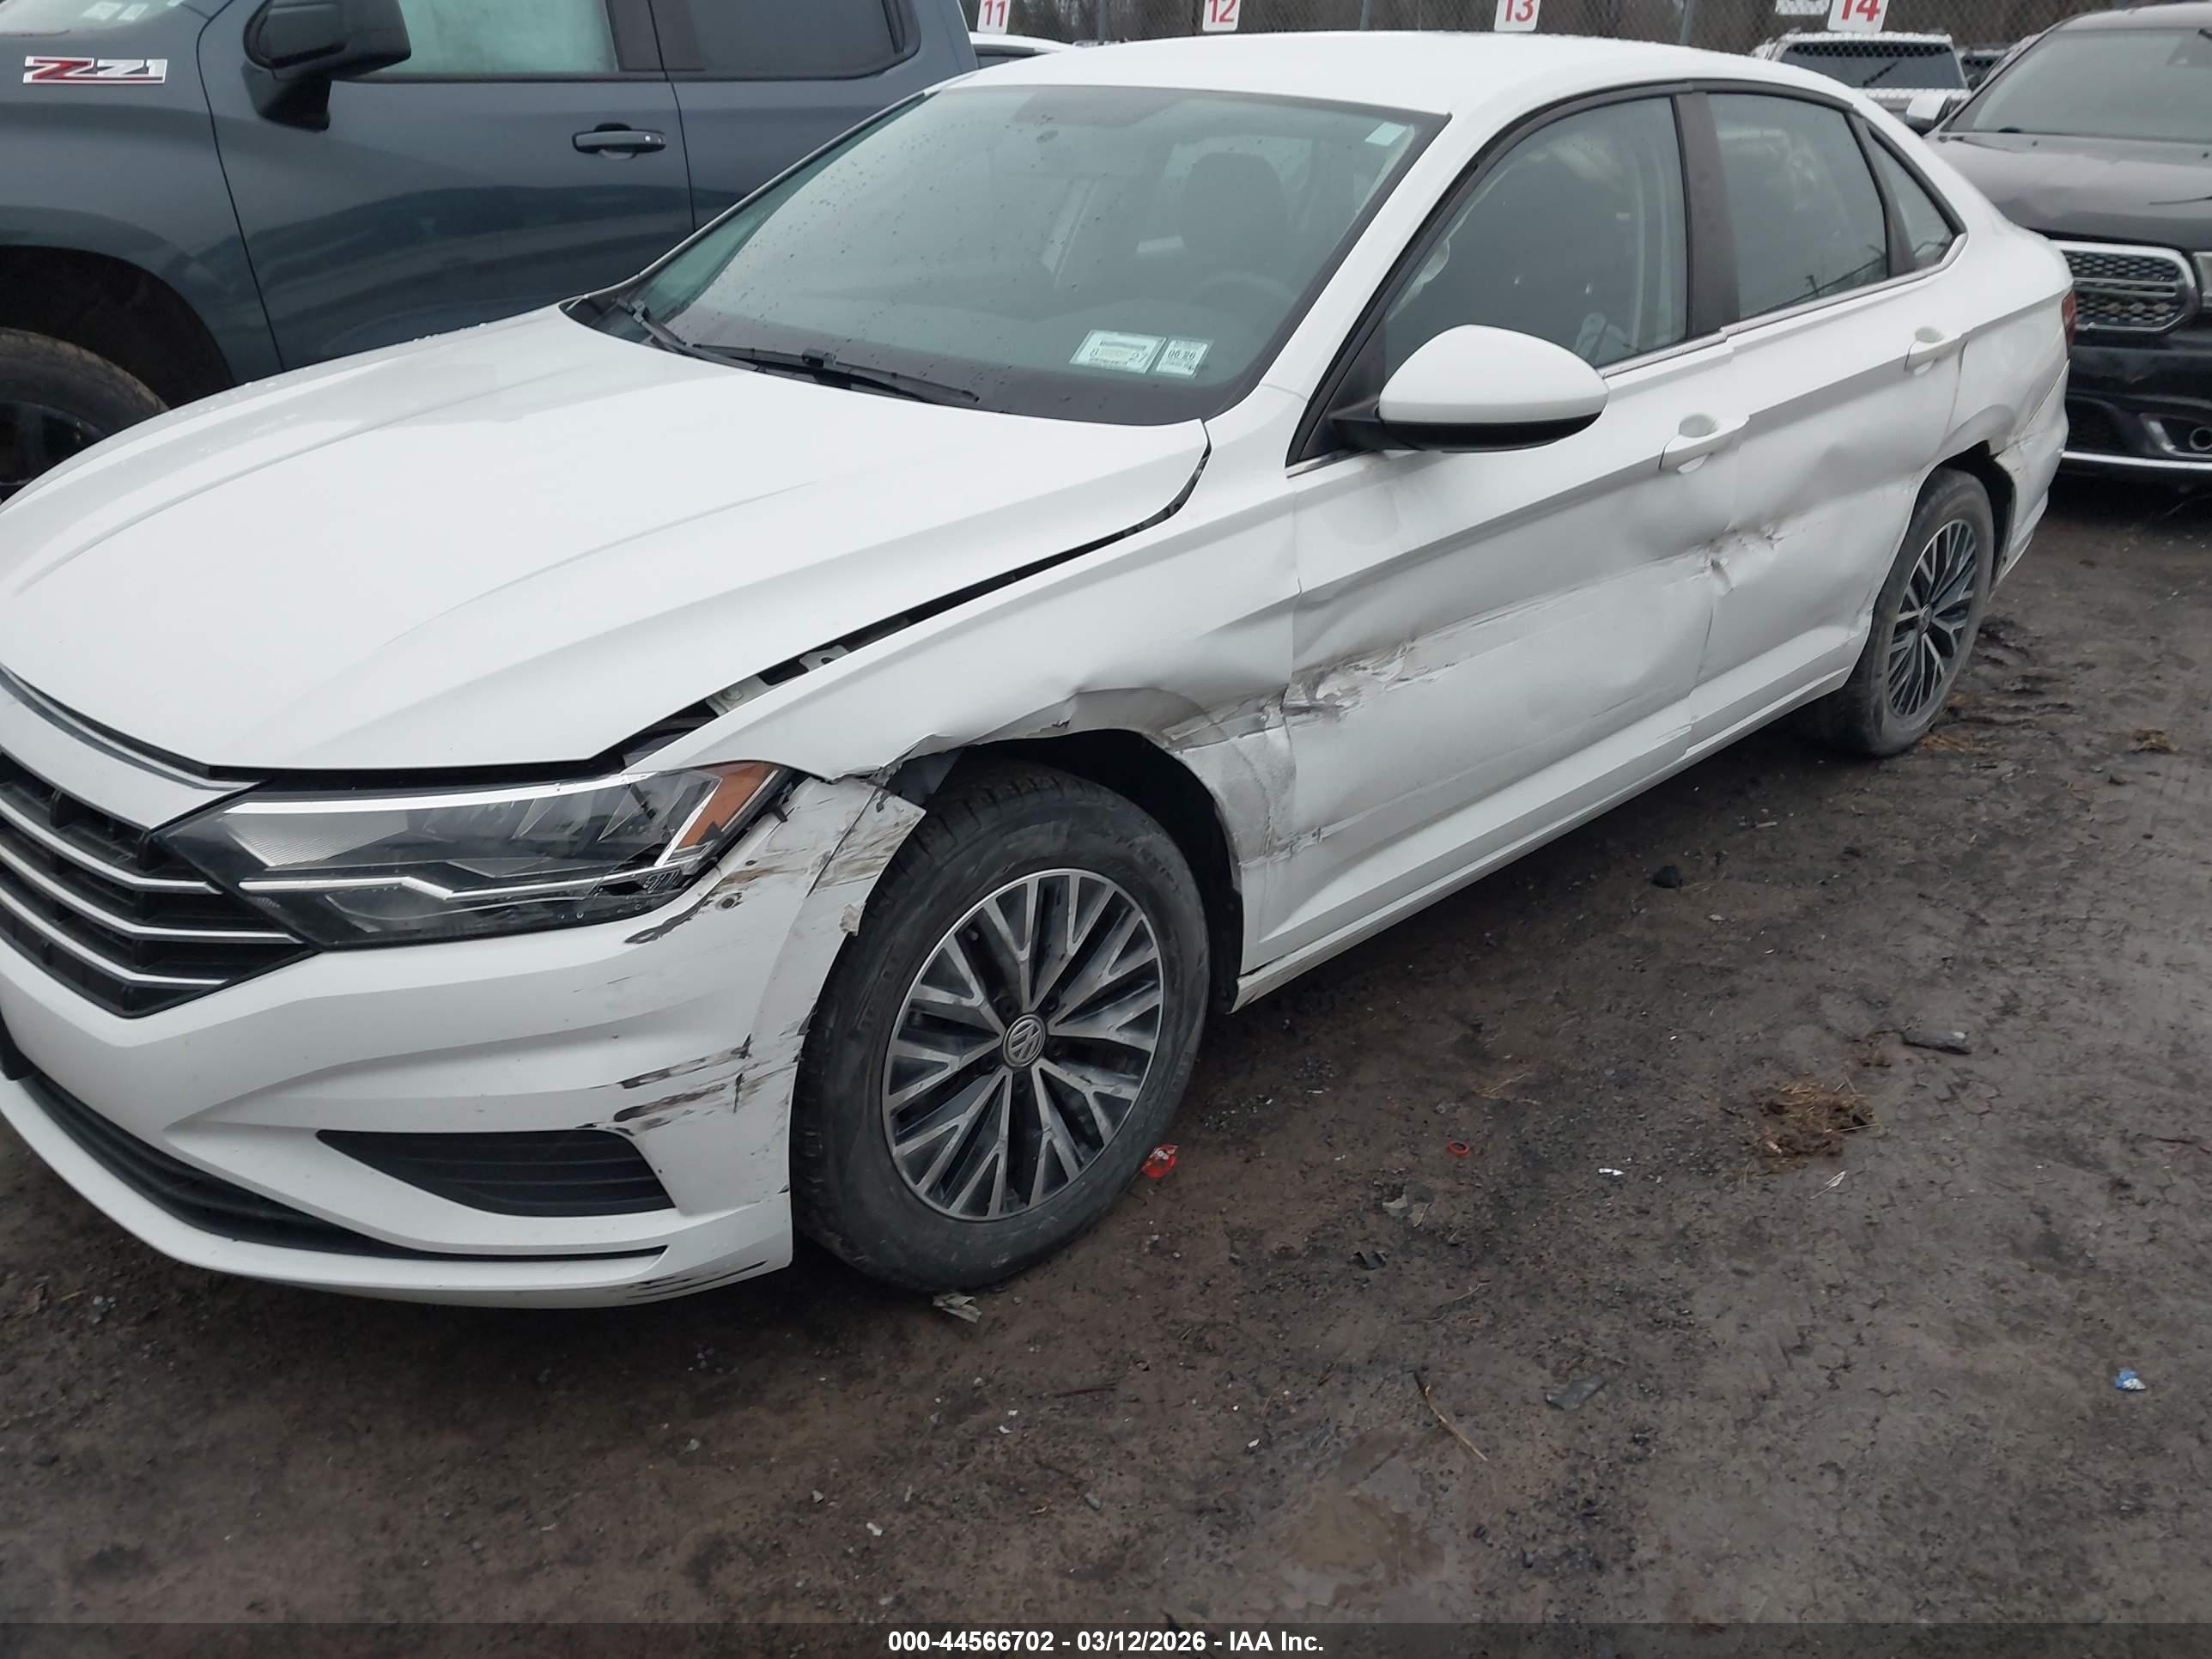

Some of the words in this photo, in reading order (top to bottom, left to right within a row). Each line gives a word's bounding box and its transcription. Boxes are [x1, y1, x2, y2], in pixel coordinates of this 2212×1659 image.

[984, 0, 1006, 27] 11
[1209, 0, 1237, 22] 12
[1504, 0, 1534, 22] 13
[1841, 0, 1881, 22] 14
[22, 55, 168, 84] Z71
